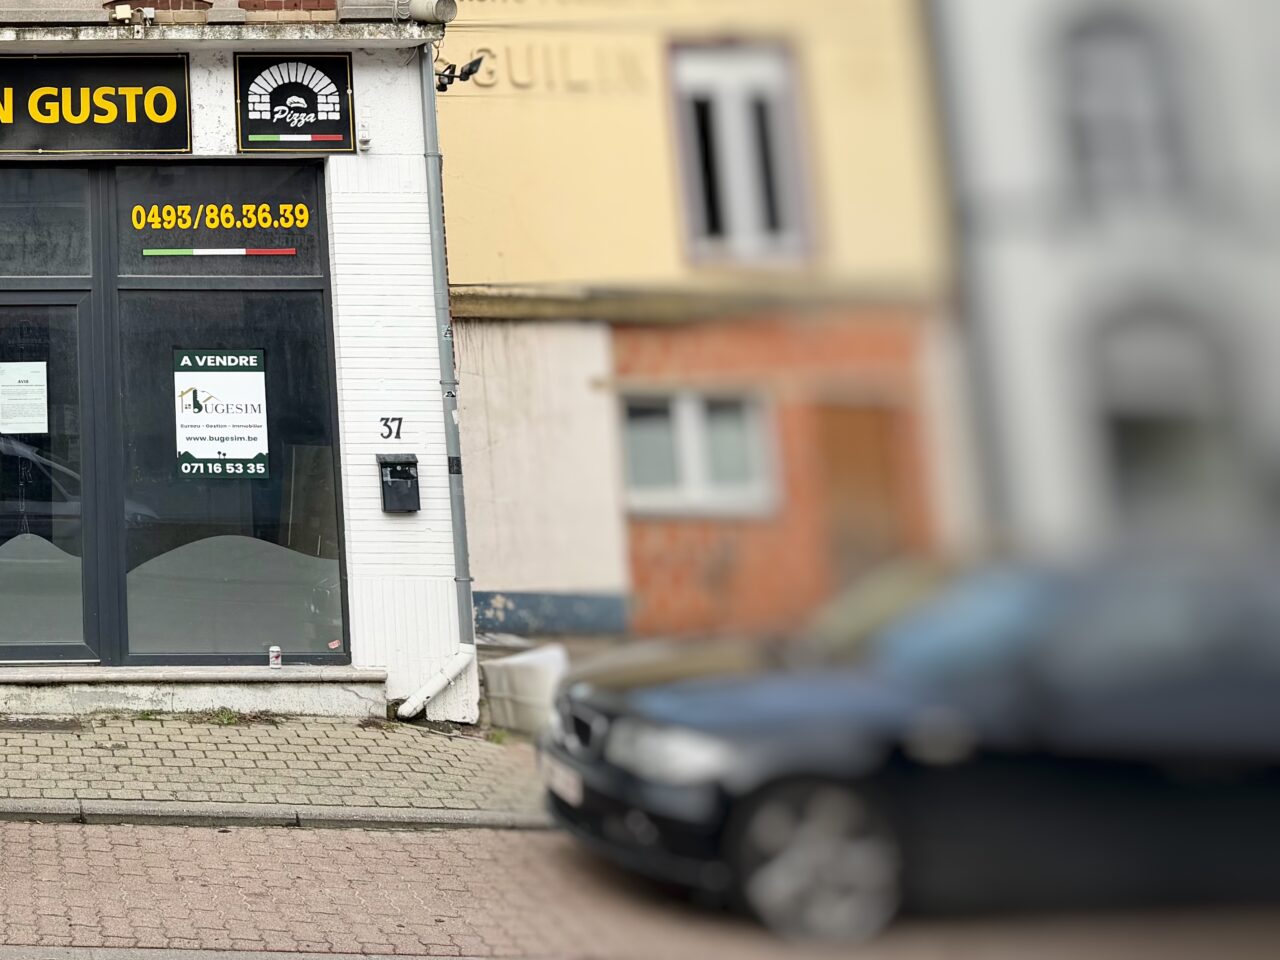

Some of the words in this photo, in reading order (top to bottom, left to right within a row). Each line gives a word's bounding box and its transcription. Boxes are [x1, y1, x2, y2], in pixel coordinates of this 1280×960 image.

[28, 85, 177, 124] GUSTO
[272, 106, 317, 127] Pizza
[131, 203, 310, 230] 0493/86.36.39
[180, 355, 192, 366] A
[195, 355, 258, 366] VENDRE
[380, 417, 403, 439] 37
[186, 435, 258, 443] www.bugesim.be
[181, 462, 205, 474] 071
[207, 462, 222, 473] 16
[225, 462, 244, 473] 53
[246, 462, 265, 473] 35
